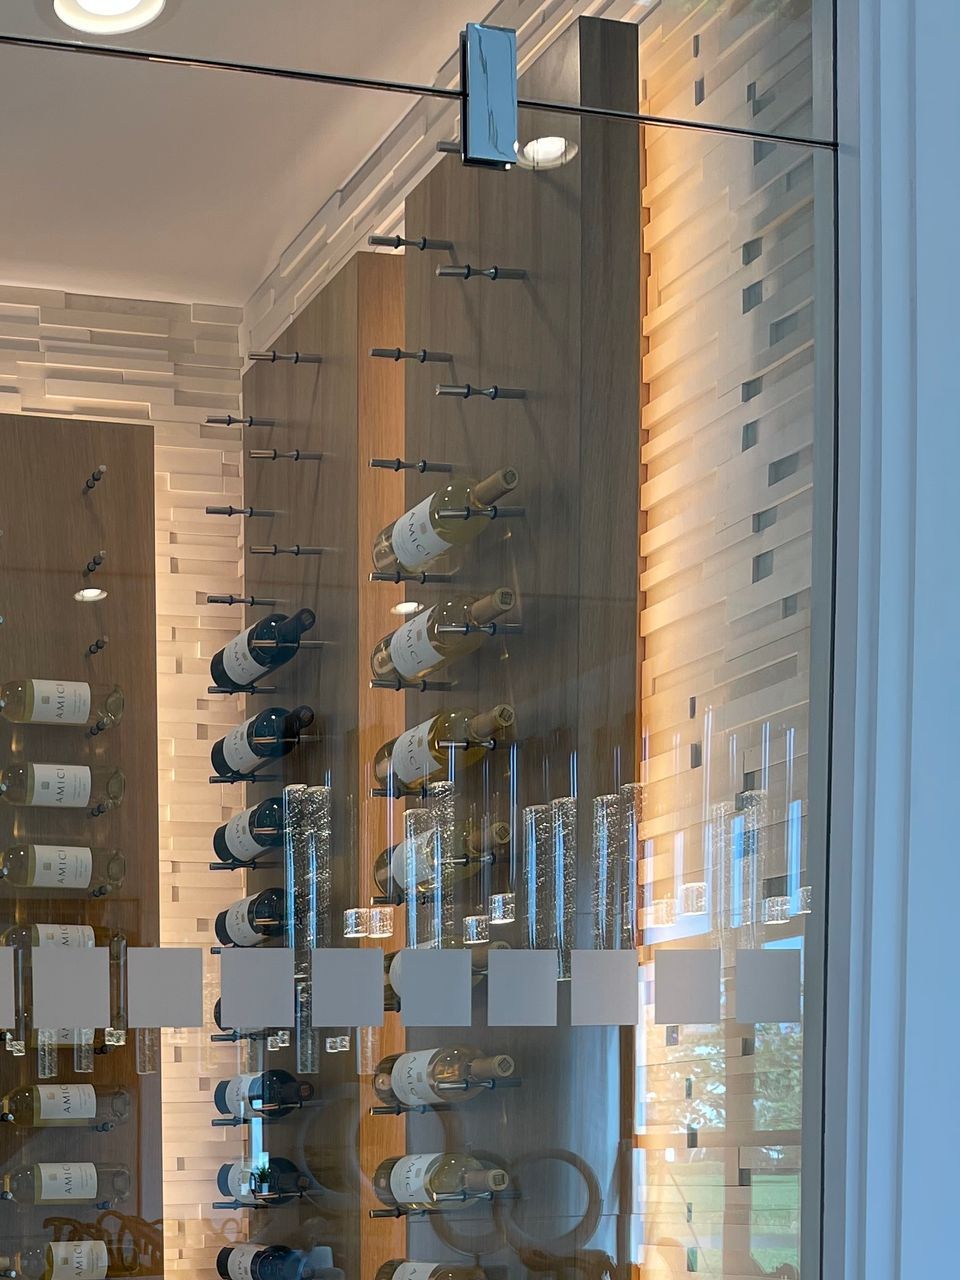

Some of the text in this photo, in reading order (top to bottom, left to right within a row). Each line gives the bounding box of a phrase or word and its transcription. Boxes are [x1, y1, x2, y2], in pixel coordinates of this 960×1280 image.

[409, 512, 431, 556] AMICI
[55, 683, 65, 719] AMICI
[56, 769, 66, 803] AMICI
[56, 850, 67, 884] AMICI
[60, 925, 70, 945] MIC
[60, 1086, 72, 1113] AMIC
[63, 1163, 72, 1194] AMIC
[73, 1244, 83, 1277] AMICI
